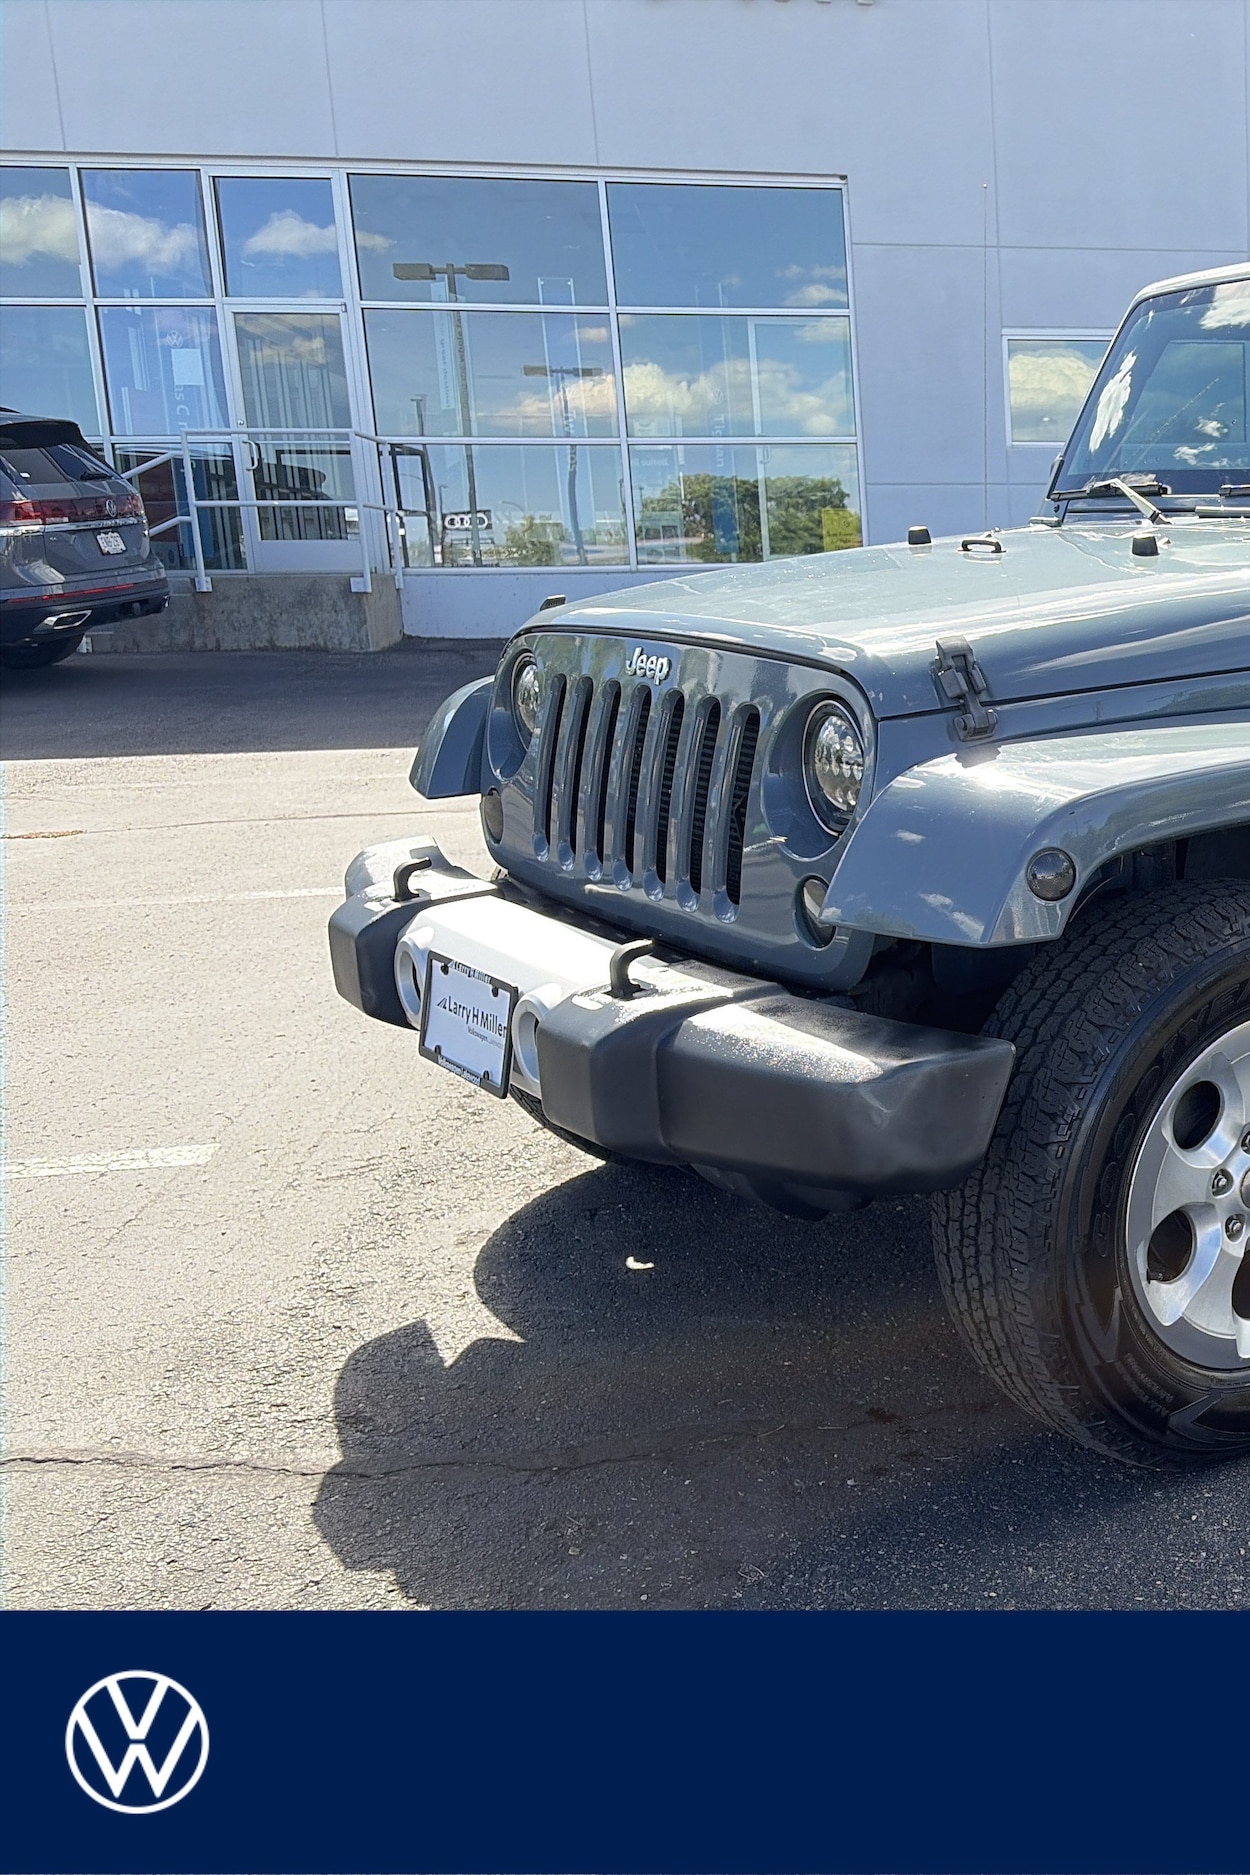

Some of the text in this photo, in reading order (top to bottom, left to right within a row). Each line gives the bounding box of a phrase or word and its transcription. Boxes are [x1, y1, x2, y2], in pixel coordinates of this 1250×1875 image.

[625, 647, 671, 685] Jeep
[448, 996, 507, 1039] Larry H Miller
